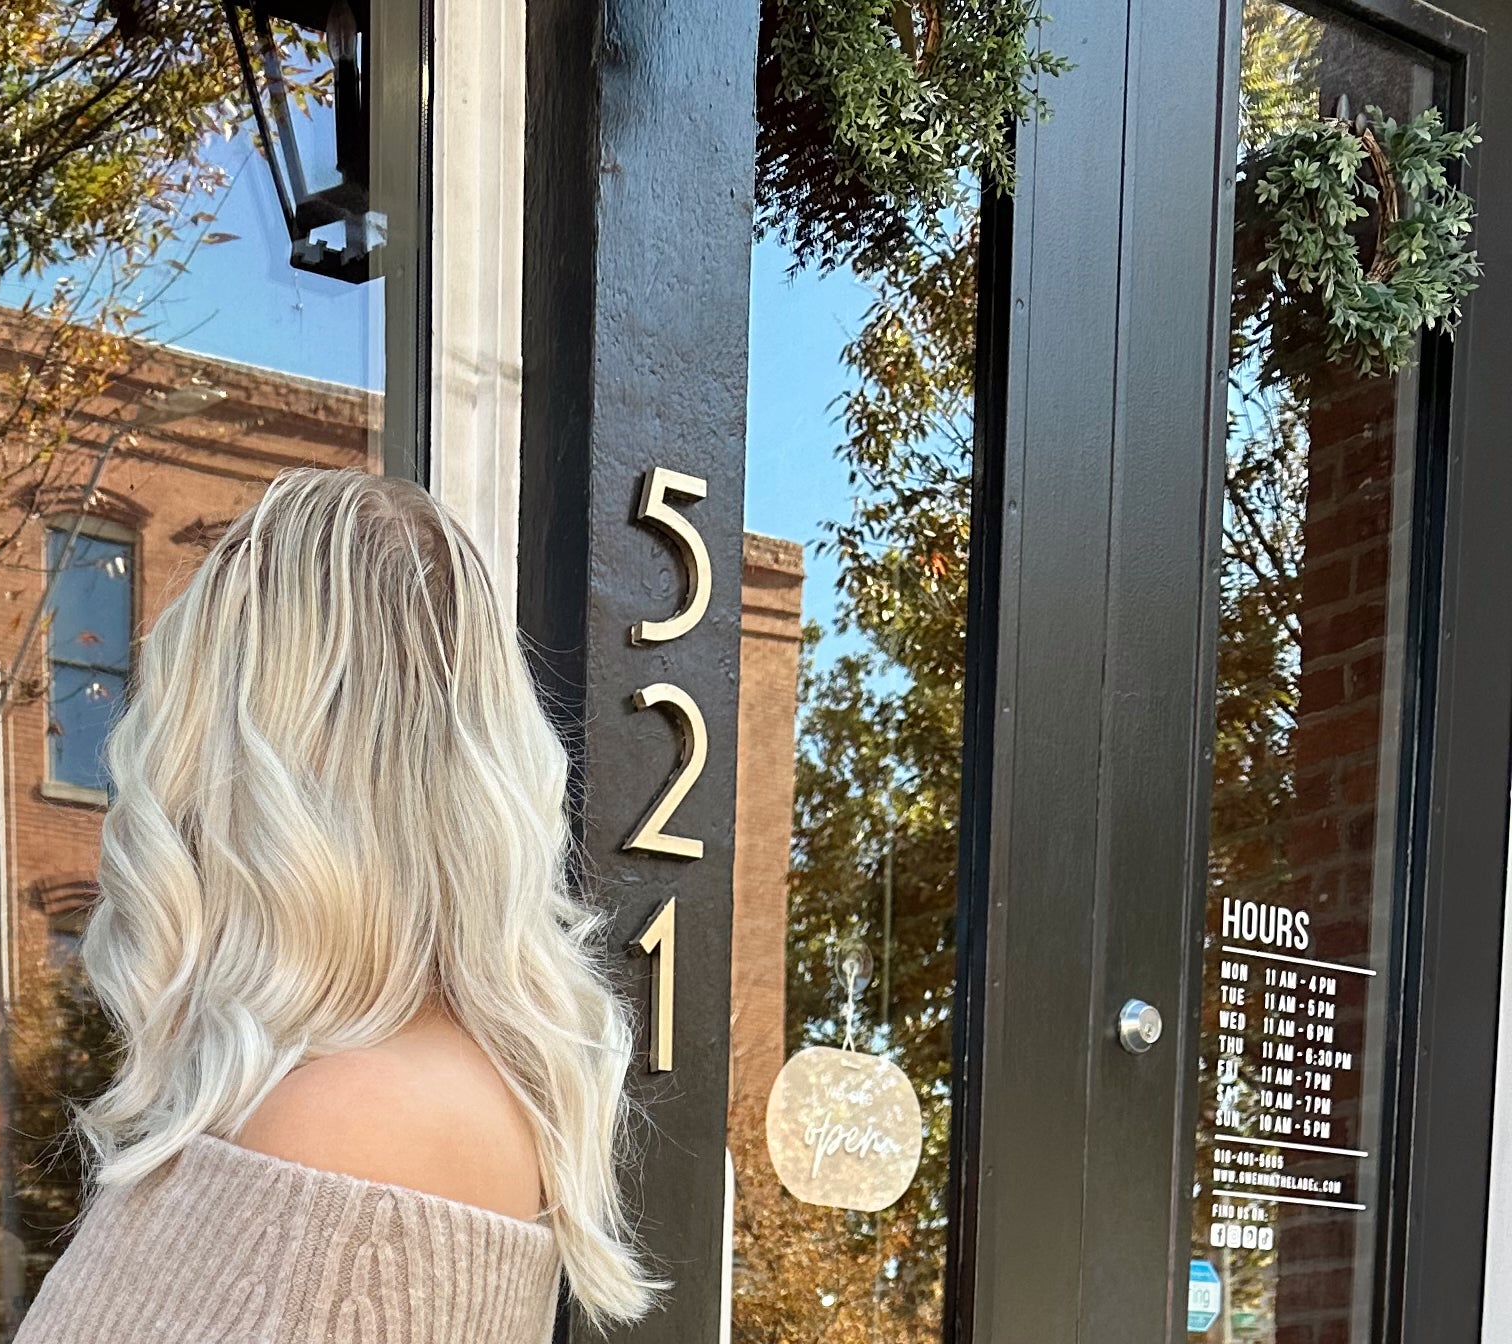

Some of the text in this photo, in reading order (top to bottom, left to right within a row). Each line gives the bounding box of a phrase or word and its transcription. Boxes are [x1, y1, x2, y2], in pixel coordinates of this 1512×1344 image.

[1222, 897, 1310, 950] HOURS
[1221, 960, 1249, 982] MON
[1265, 967, 1277, 986] 11
[1279, 969, 1298, 990] AM
[1308, 975, 1317, 993] 4
[1319, 976, 1336, 996] PM
[1220, 985, 1245, 1006] TUE
[1264, 992, 1275, 1011] 11
[1278, 994, 1296, 1014] AM
[1317, 1000, 1335, 1020] PM
[1219, 1010, 1246, 1031] WED
[1263, 1016, 1274, 1035] 11
[1276, 1019, 1295, 1038] AM
[1316, 1025, 1334, 1044] PM
[1218, 1034, 1244, 1055] THU
[1262, 1041, 1273, 1060] 11
[1275, 1043, 1294, 1062] AM
[1335, 1050, 1352, 1070] PM
[1217, 1059, 1239, 1078] FRI
[1261, 1065, 1272, 1084] 11
[1275, 1067, 1293, 1087] AM
[1304, 1071, 1312, 1089] 7
[1314, 1072, 1331, 1092] PM
[1216, 1084, 1240, 1104] SAT
[1260, 1089, 1273, 1108] 10
[1275, 1091, 1293, 1111] AM
[1304, 1095, 1312, 1113] 7
[1314, 1096, 1331, 1115] PM
[1215, 1109, 1240, 1128] SUN
[1259, 1114, 1272, 1132] 10
[1274, 1116, 1293, 1135] AM
[1313, 1120, 1331, 1139] PM
[804, 1111, 902, 1180] open
[1212, 1203, 1235, 1219] FIND
[1237, 1206, 1248, 1220] US
[1189, 1288, 1211, 1308] ing
